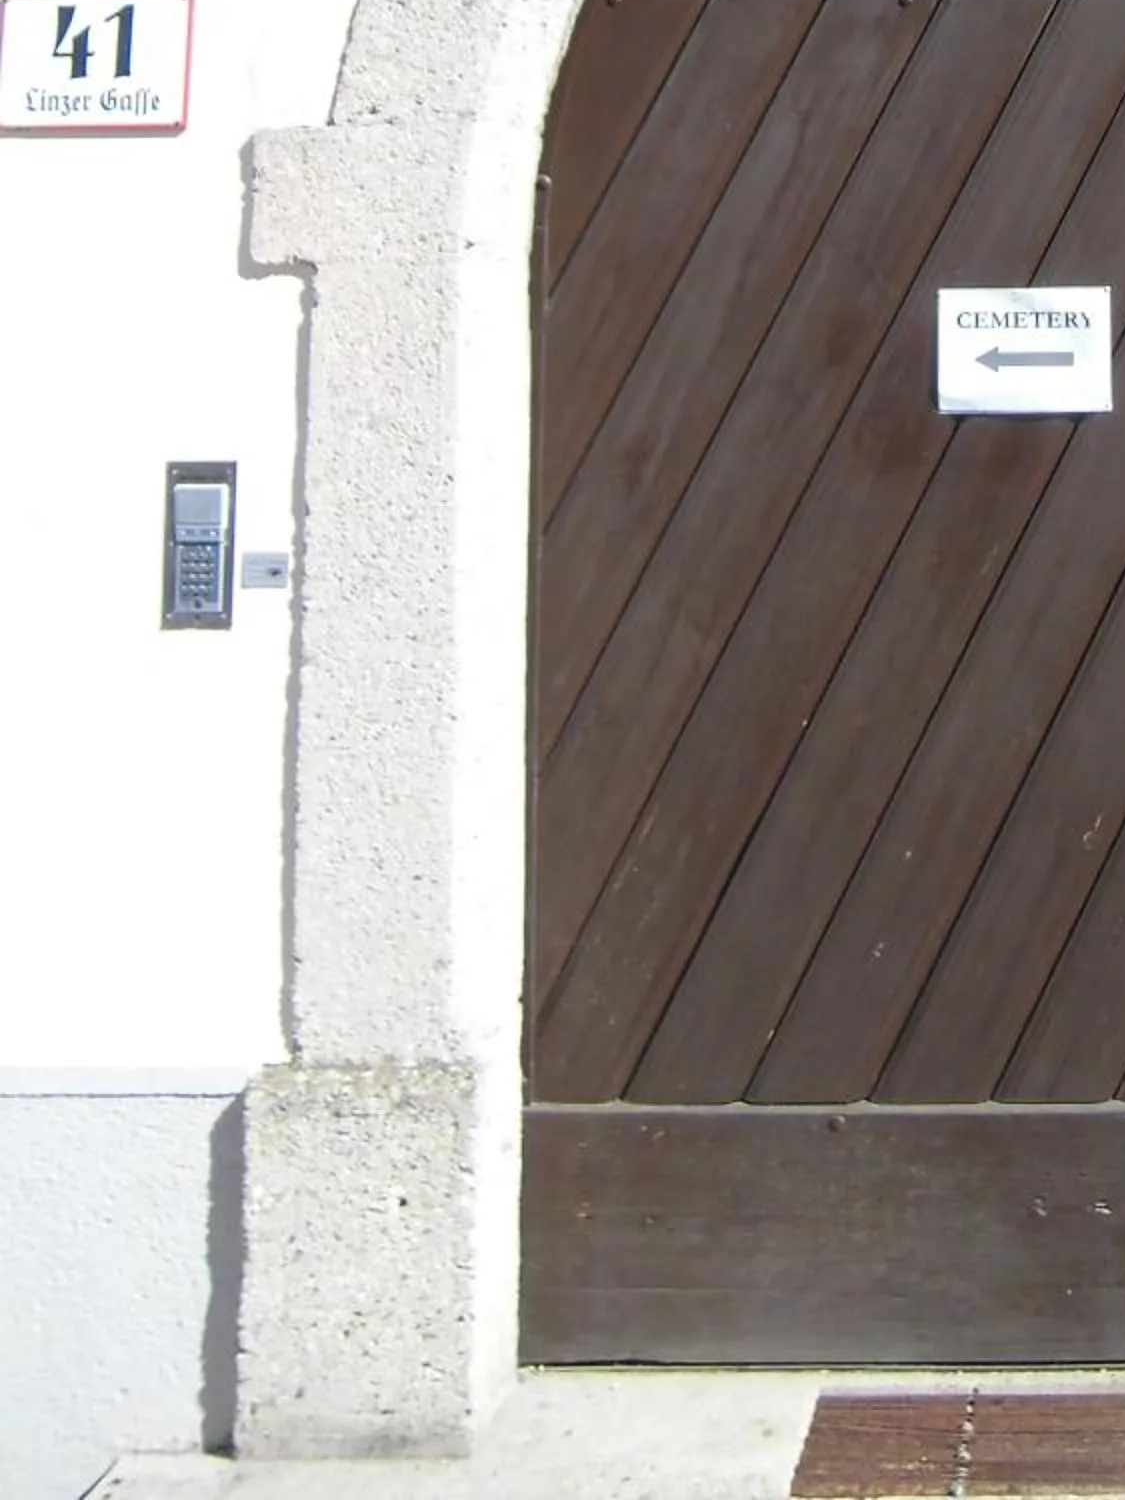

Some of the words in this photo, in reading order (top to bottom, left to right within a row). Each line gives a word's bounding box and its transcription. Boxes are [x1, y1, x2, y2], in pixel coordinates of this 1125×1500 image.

[52, 3, 135, 80] 41
[25, 86, 93, 117] Linzer
[99, 86, 161, 117] Gasse
[956, 309, 1092, 330] CEMETERY
